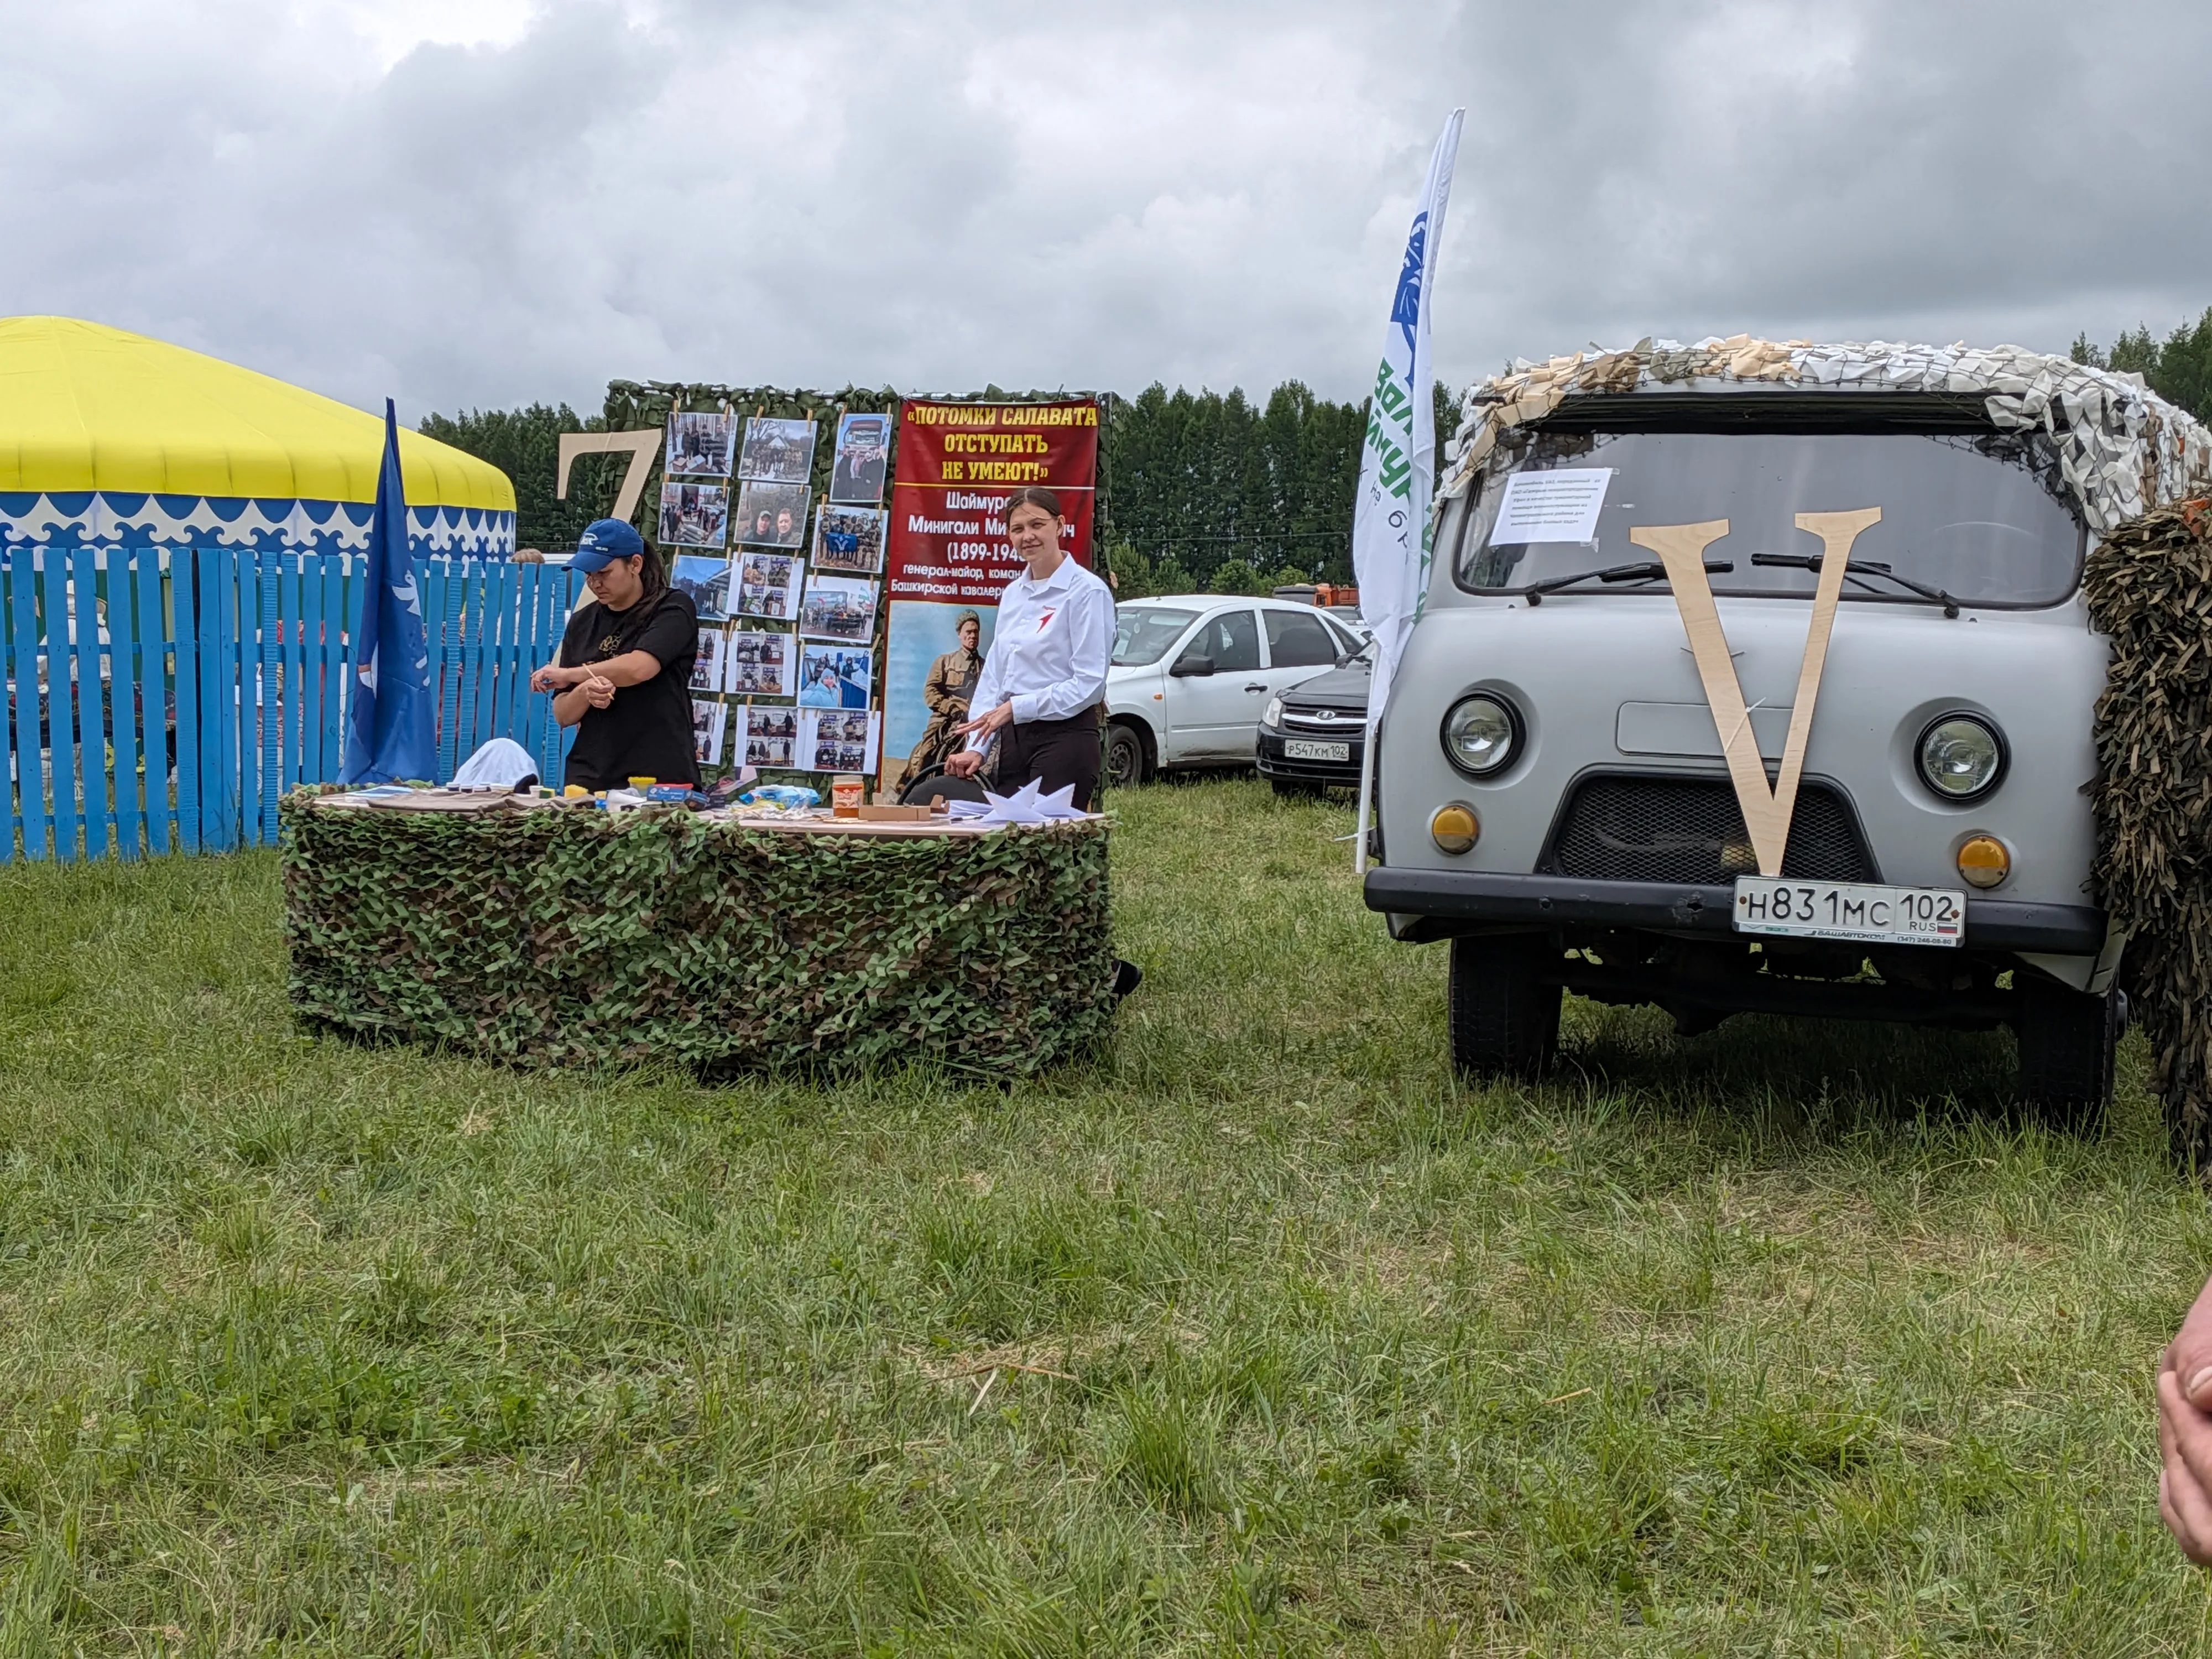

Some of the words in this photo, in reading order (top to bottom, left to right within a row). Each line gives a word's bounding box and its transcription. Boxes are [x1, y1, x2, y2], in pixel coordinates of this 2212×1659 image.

[907, 406, 996, 425] «ПОТОМКИ
[1001, 407, 1098, 426] САЛАВАТА
[944, 434, 1048, 453] ОТСТУПАТЬ
[942, 461, 963, 480] НЕ
[968, 462, 1048, 481] УМЕЮТ!»
[908, 514, 979, 535] Минигали
[902, 564, 984, 581] генерал-майор,
[989, 568, 1023, 580] коман
[891, 579, 958, 596] Башкирской
[961, 585, 1003, 600] кавалер
[1629, 506, 1882, 877] V
[1748, 887, 1890, 927] Н831МС
[1900, 894, 1953, 922] 102
[1910, 921, 1936, 932] RUS
